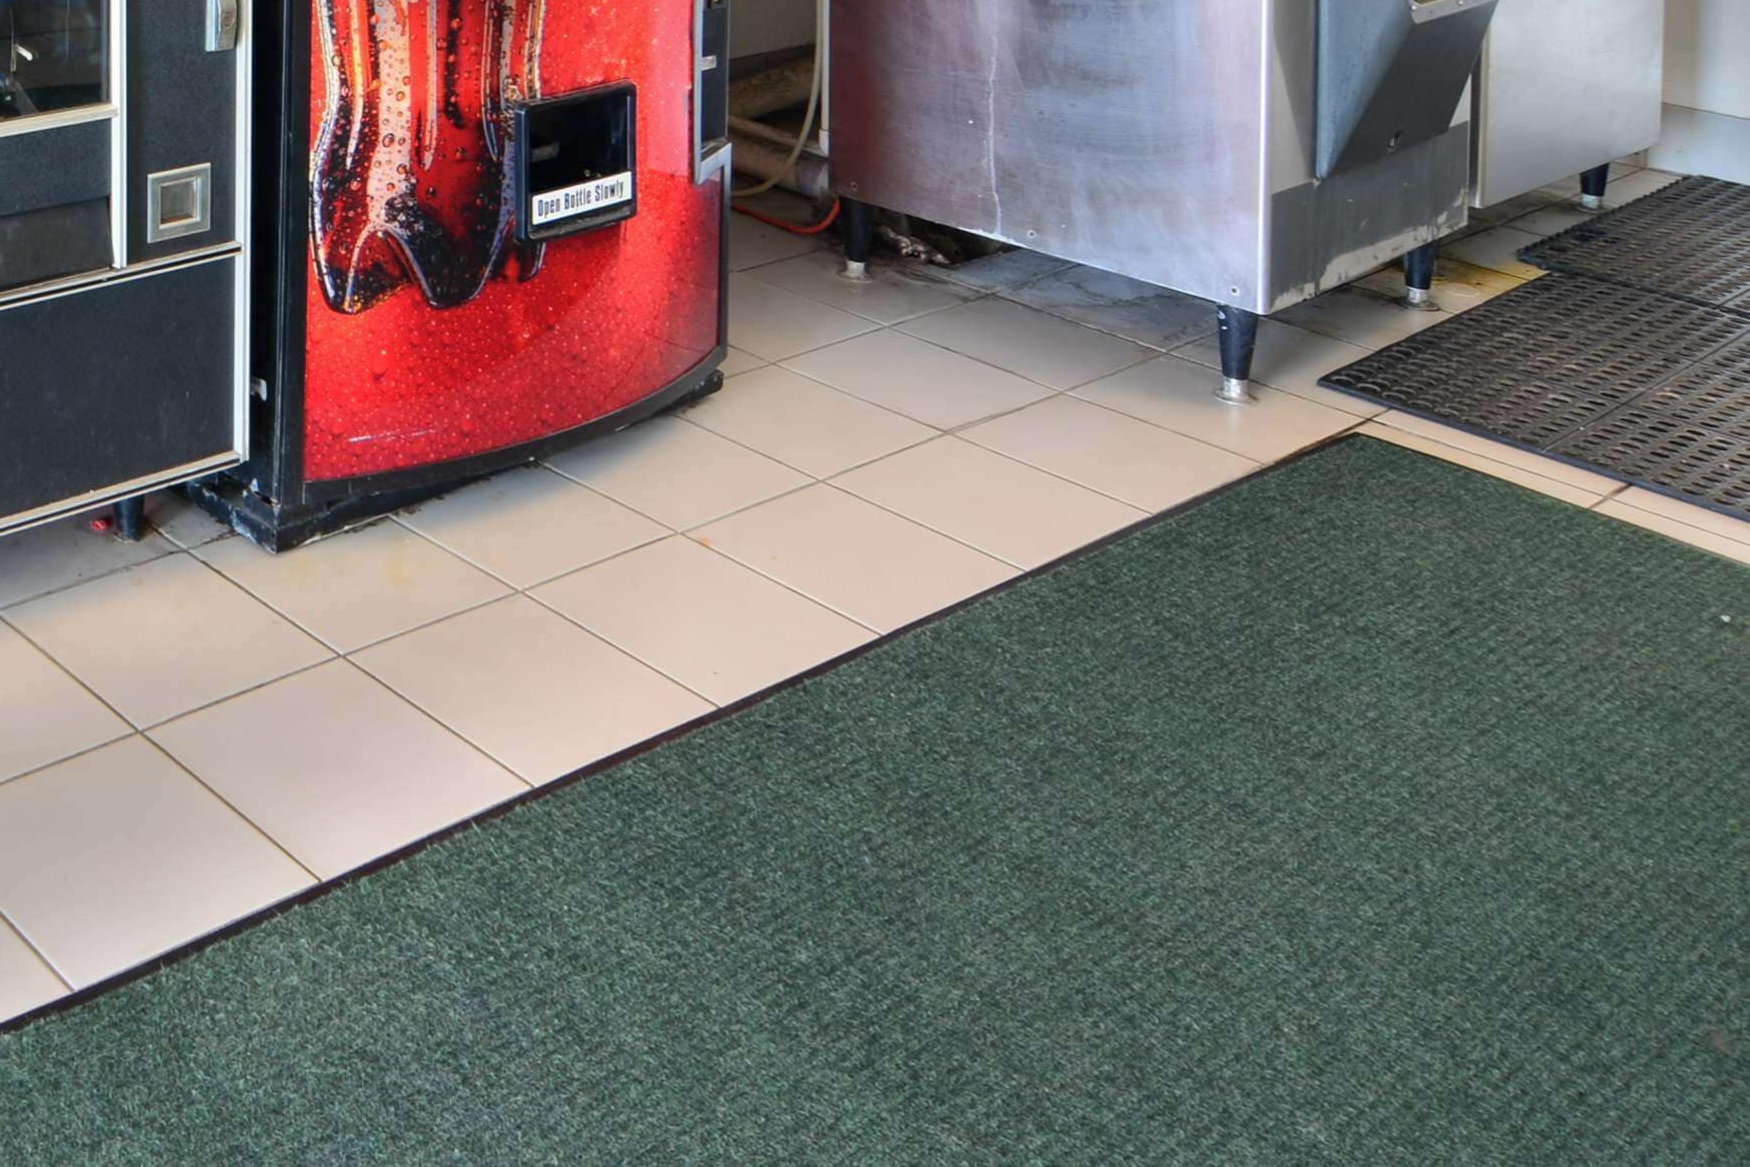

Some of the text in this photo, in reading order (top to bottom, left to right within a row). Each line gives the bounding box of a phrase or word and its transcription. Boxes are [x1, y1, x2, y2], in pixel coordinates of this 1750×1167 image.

[537, 179, 625, 218] Open Bottle Slowly
